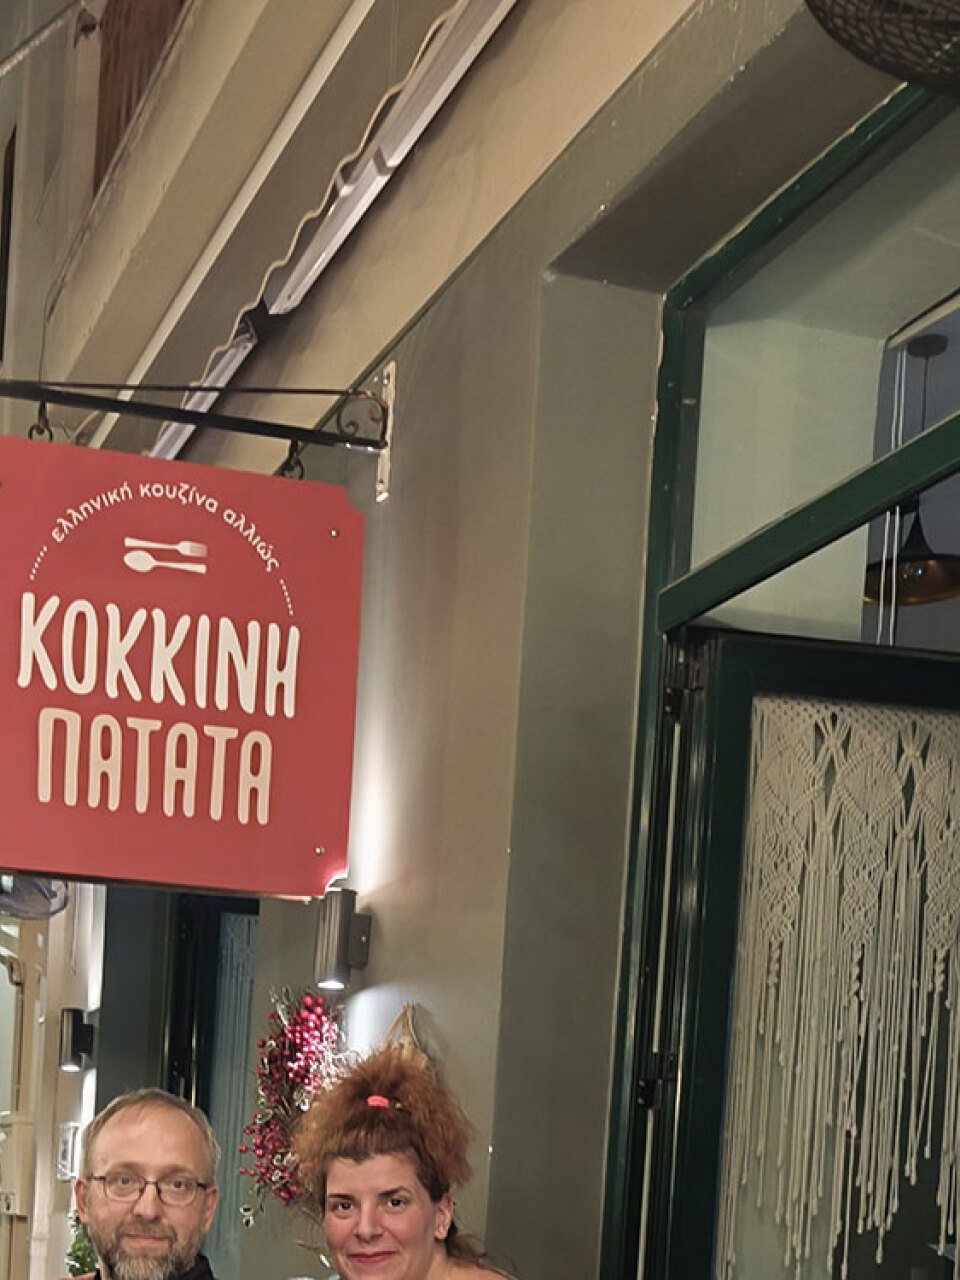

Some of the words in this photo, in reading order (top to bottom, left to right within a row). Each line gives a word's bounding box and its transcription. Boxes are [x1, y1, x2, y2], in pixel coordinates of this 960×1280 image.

[51, 481, 133, 543] ελληνική
[139, 482, 219, 513] κουζίνα
[222, 508, 280, 573] αλλιώς
[16, 591, 301, 719] ΚΟΚΚΙΝΗ
[37, 707, 273, 826] ΠΑΤΑΤΑ
